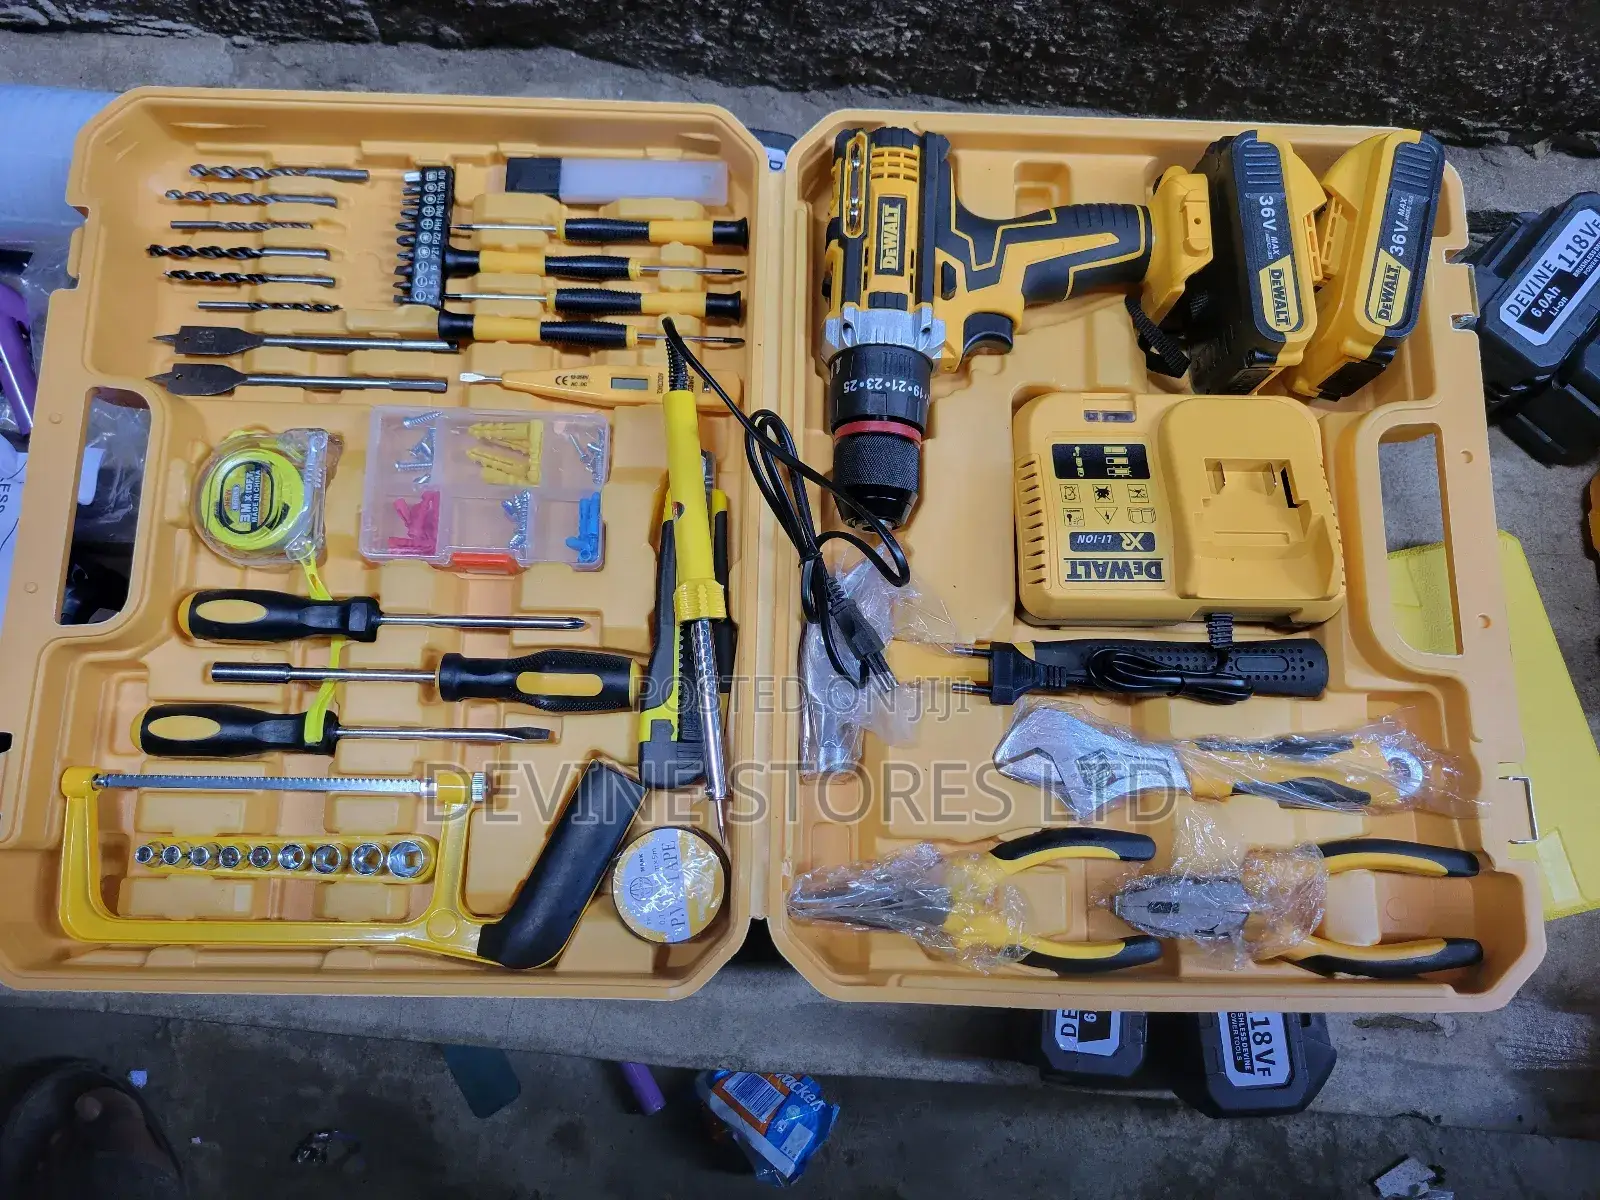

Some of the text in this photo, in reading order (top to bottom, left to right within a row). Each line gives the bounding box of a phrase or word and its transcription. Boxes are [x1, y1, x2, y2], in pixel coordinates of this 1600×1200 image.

[1260, 195, 1276, 231] 36V
[1270, 236, 1280, 255] MAX
[1390, 197, 1408, 257] 36V MAX
[1506, 260, 1558, 318] DEVINE
[1530, 286, 1562, 318] 6.0Ah
[844, 379, 858, 394] 25
[866, 377, 883, 390] 23
[892, 380, 906, 393] 21
[1077, 533, 1144, 550] XR LI-ION
[1061, 1010, 1077, 1037] DE
[1234, 1036, 1242, 1061] TOOLS
[1238, 1012, 1251, 1070] SHLESS DEVINE
[1249, 1012, 1276, 1076] 18VF
